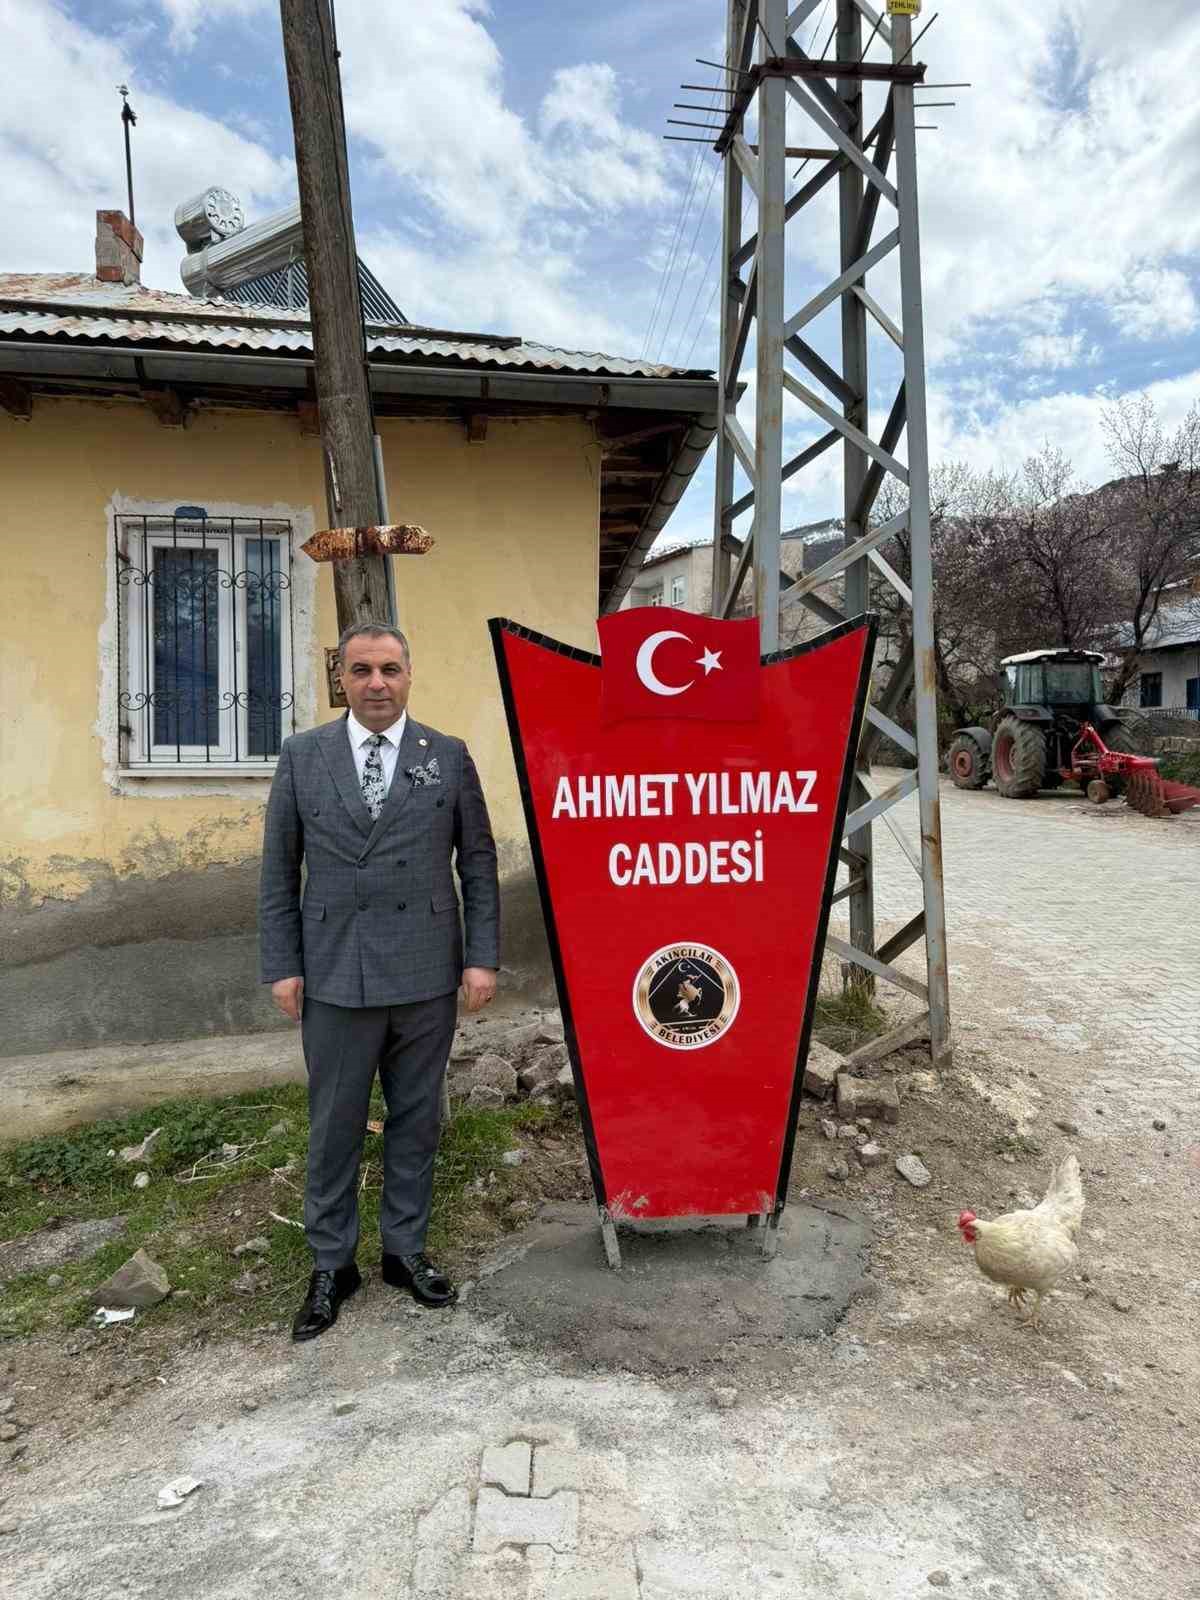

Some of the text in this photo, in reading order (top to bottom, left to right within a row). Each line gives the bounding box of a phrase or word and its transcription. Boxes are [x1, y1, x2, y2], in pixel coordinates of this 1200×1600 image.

[551, 770, 819, 819] AHMET YILMAZ
[609, 829, 765, 886] CADDESİ
[654, 948, 714, 969] AKINCILAR
